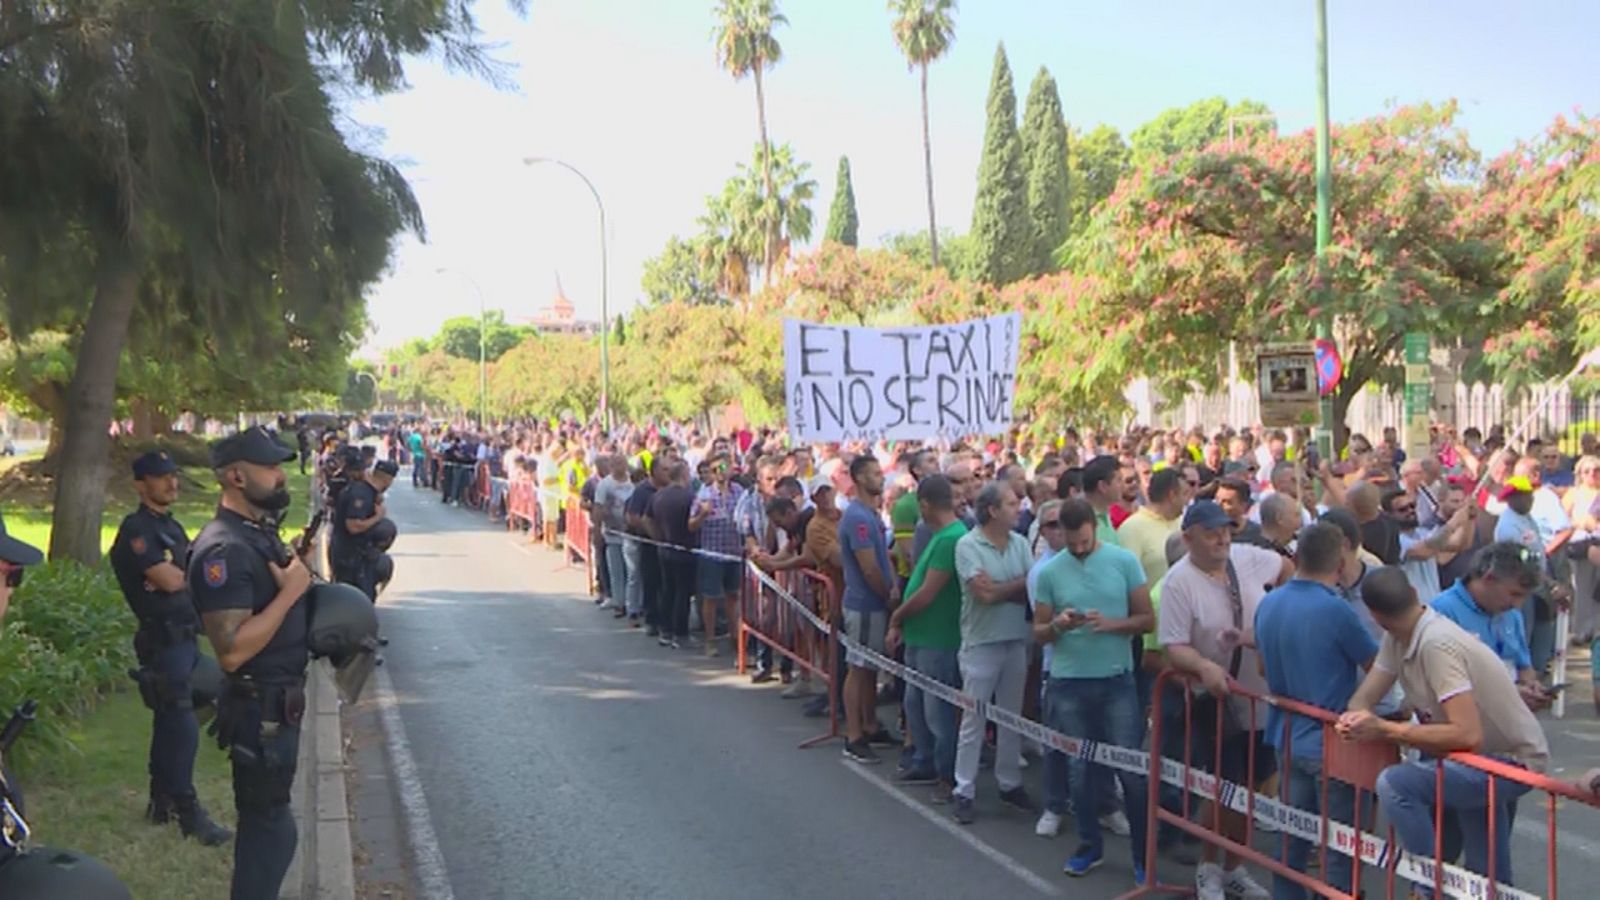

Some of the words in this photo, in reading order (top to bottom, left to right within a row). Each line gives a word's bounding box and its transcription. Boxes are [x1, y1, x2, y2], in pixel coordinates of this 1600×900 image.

[800, 323, 875, 377] EL
[881, 320, 992, 379] TAXI
[811, 377, 874, 431] NO
[884, 374, 931, 428] SE
[1349, 835, 1377, 859] PSAR
